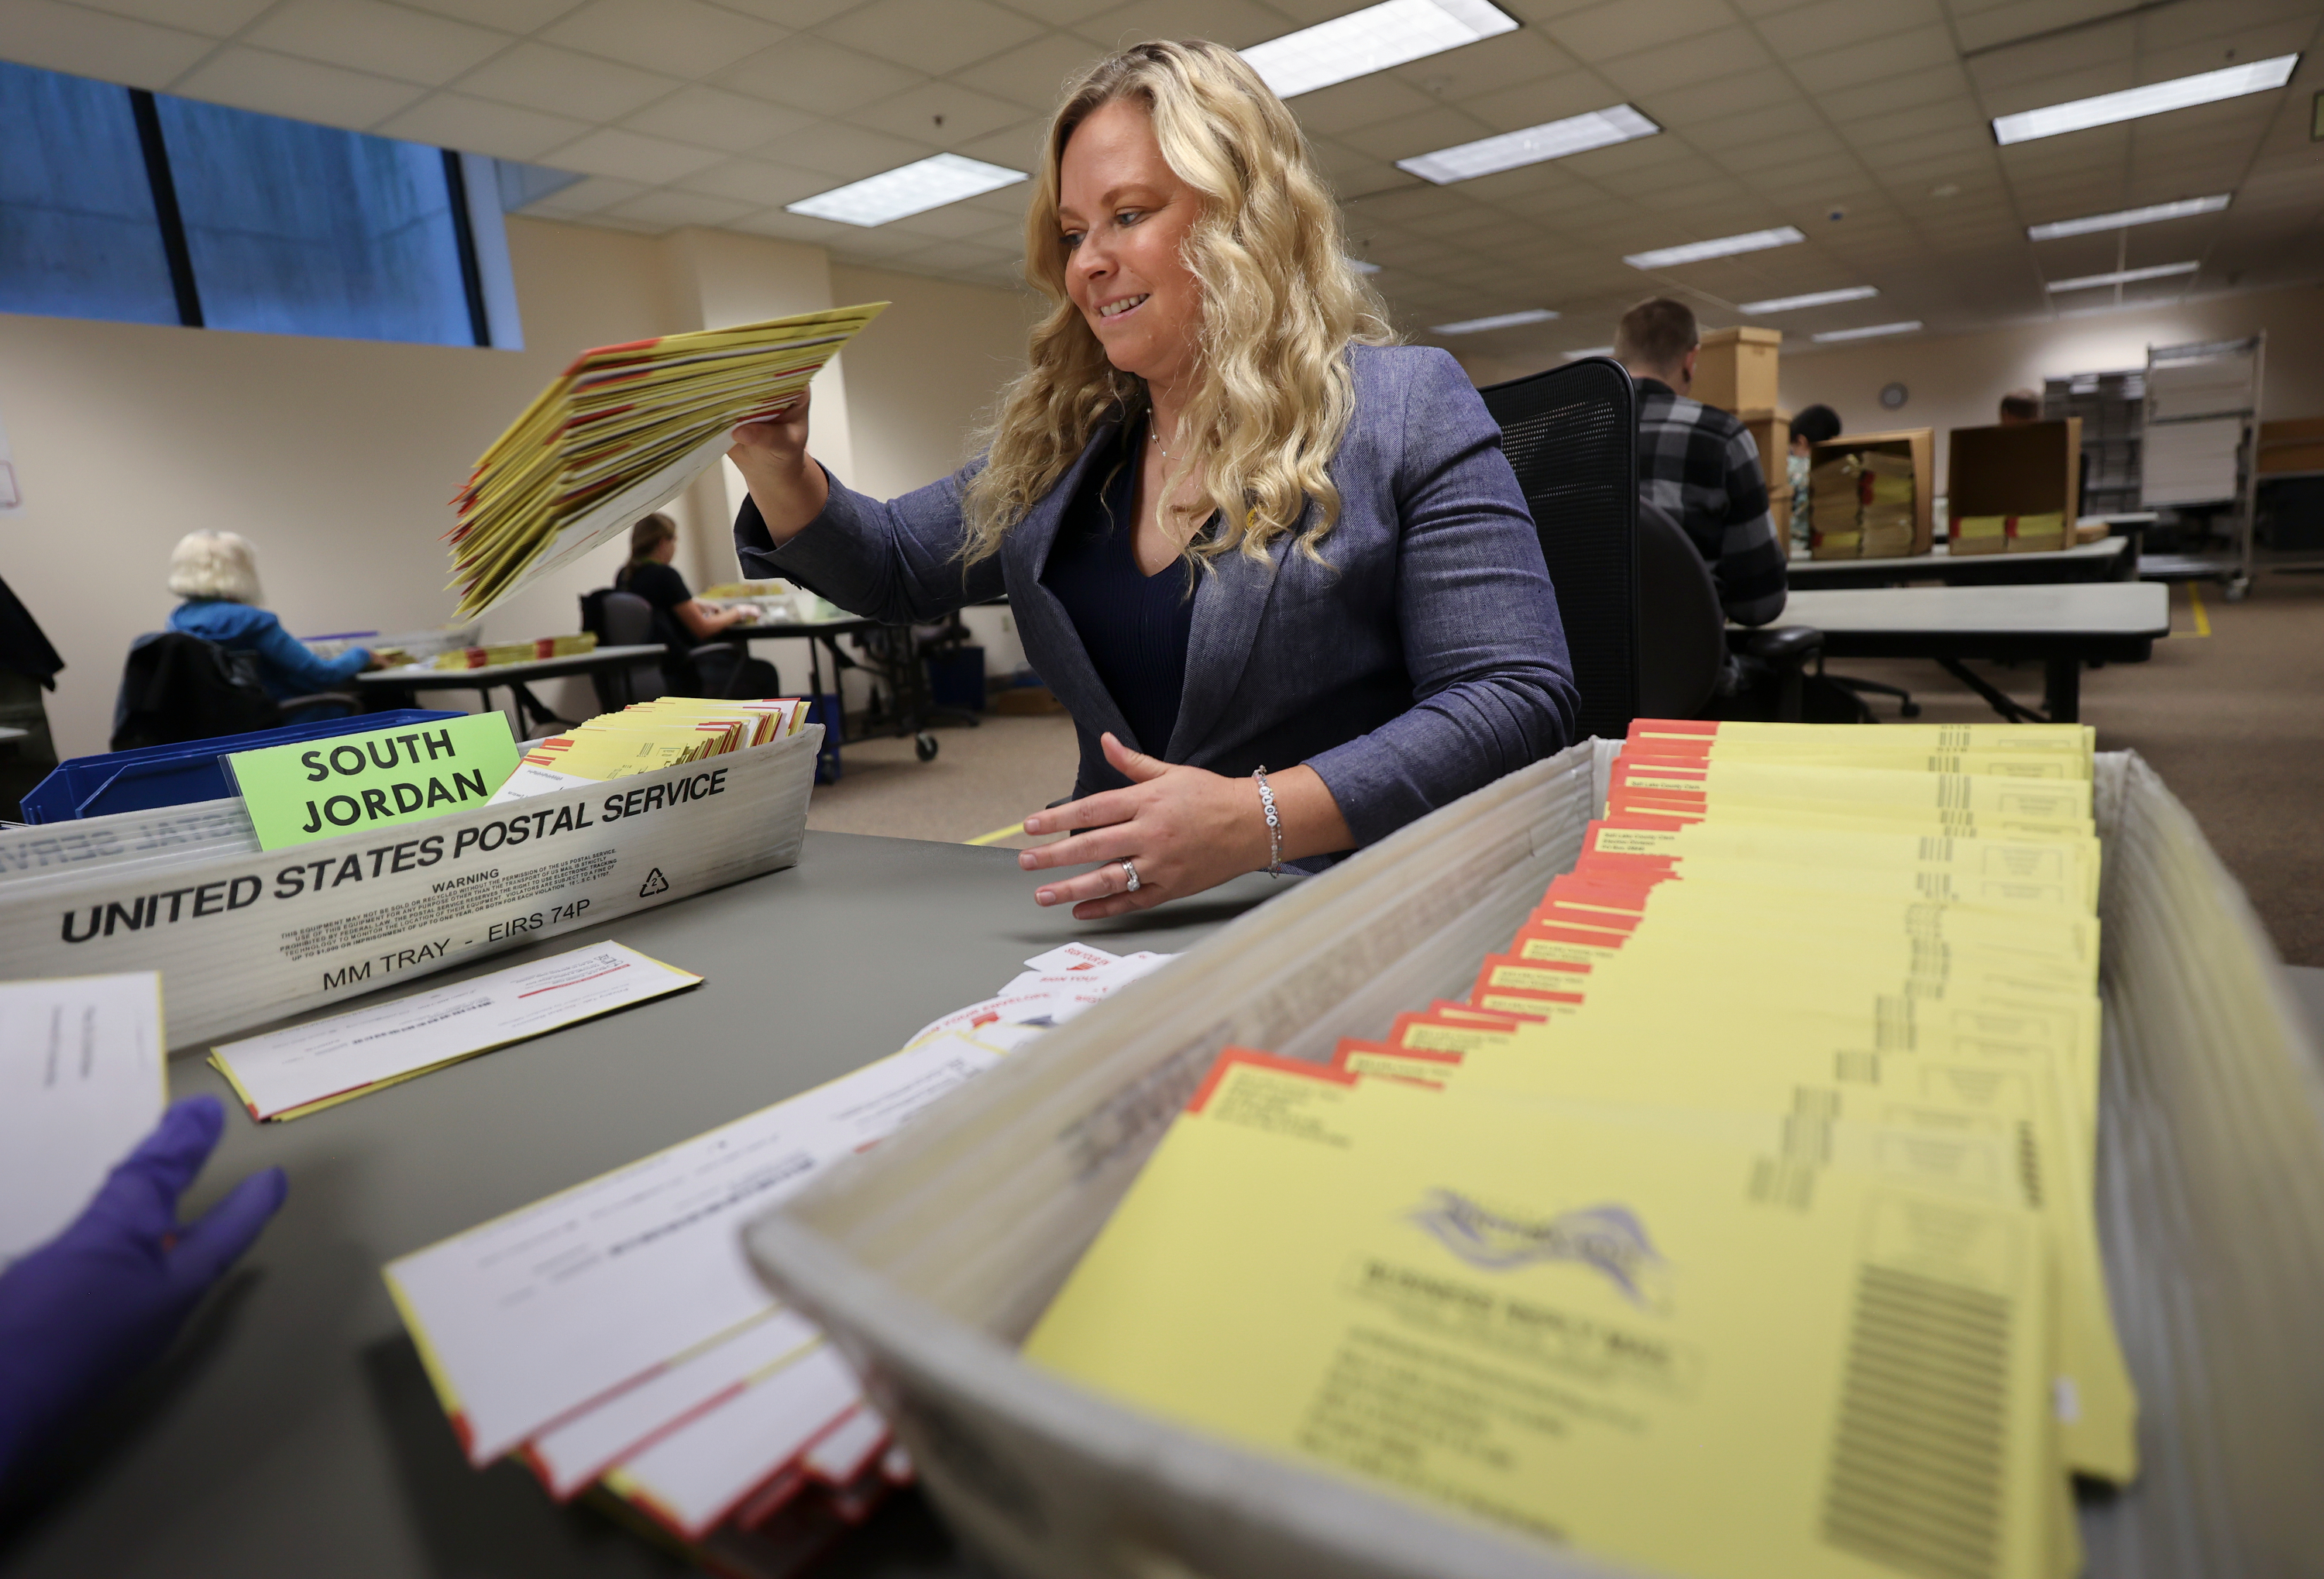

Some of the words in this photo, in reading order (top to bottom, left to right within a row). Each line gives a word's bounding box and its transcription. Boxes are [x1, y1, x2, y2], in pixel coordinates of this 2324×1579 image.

[301, 729, 456, 782] SOUTH
[302, 769, 488, 833] JORDAN
[1261, 786, 1277, 825] VOTE
[61, 876, 262, 944] UNITED
[273, 836, 443, 900] STATES
[453, 802, 593, 858] POSTAL
[602, 769, 728, 822] SERVICE
[281, 930, 297, 939] THIS
[300, 918, 342, 934] EQUIPMENT
[346, 914, 360, 923] MAY
[363, 910, 377, 918] NOT
[391, 902, 409, 911] SOLD
[422, 889, 457, 903] RECYCLED
[459, 882, 486, 893] WITHOUT
[502, 869, 537, 882] PERMISSION
[570, 855, 590, 864] POSTAL
[593, 848, 616, 858] SERVICE.
[431, 868, 500, 893] WARNING
[280, 935, 325, 951] PROHIBITED
[340, 924, 372, 936] FEDERAL
[409, 907, 435, 918] POSTAL
[437, 900, 463, 910] SERVICE
[466, 890, 497, 903] RESERVES
[513, 882, 530, 890] RIGHT
[554, 866, 588, 879] ELECTRONIC
[590, 858, 617, 869] TRACKING
[285, 938, 336, 956] TECHNOLOGY
[351, 926, 382, 939] MONITOR
[400, 913, 433, 926] LOCATION
[447, 904, 464, 913] THEIR
[507, 885, 539, 898] VIOLATORS
[554, 874, 579, 885] SUBJECT
[295, 933, 309, 941] USE
[325, 925, 340, 934] THIS
[343, 914, 384, 929] EQUIPMENT
[387, 910, 400, 918] FOR
[402, 906, 415, 914] ANY
[418, 897, 449, 910] PURPOSE
[451, 892, 472, 901] OTHER
[505, 874, 540, 887] TRANSPORT
[581, 856, 606, 867] STRICTLY
[353, 927, 404, 945] IMPRISONMENT
[455, 908, 473, 917] YEAR,
[486, 900, 501, 909] BOTH
[517, 892, 532, 900] EACH
[323, 962, 371, 991] MM
[380, 937, 452, 972] TRAY
[488, 913, 543, 942] EIRS
[551, 899, 591, 924] 74P
